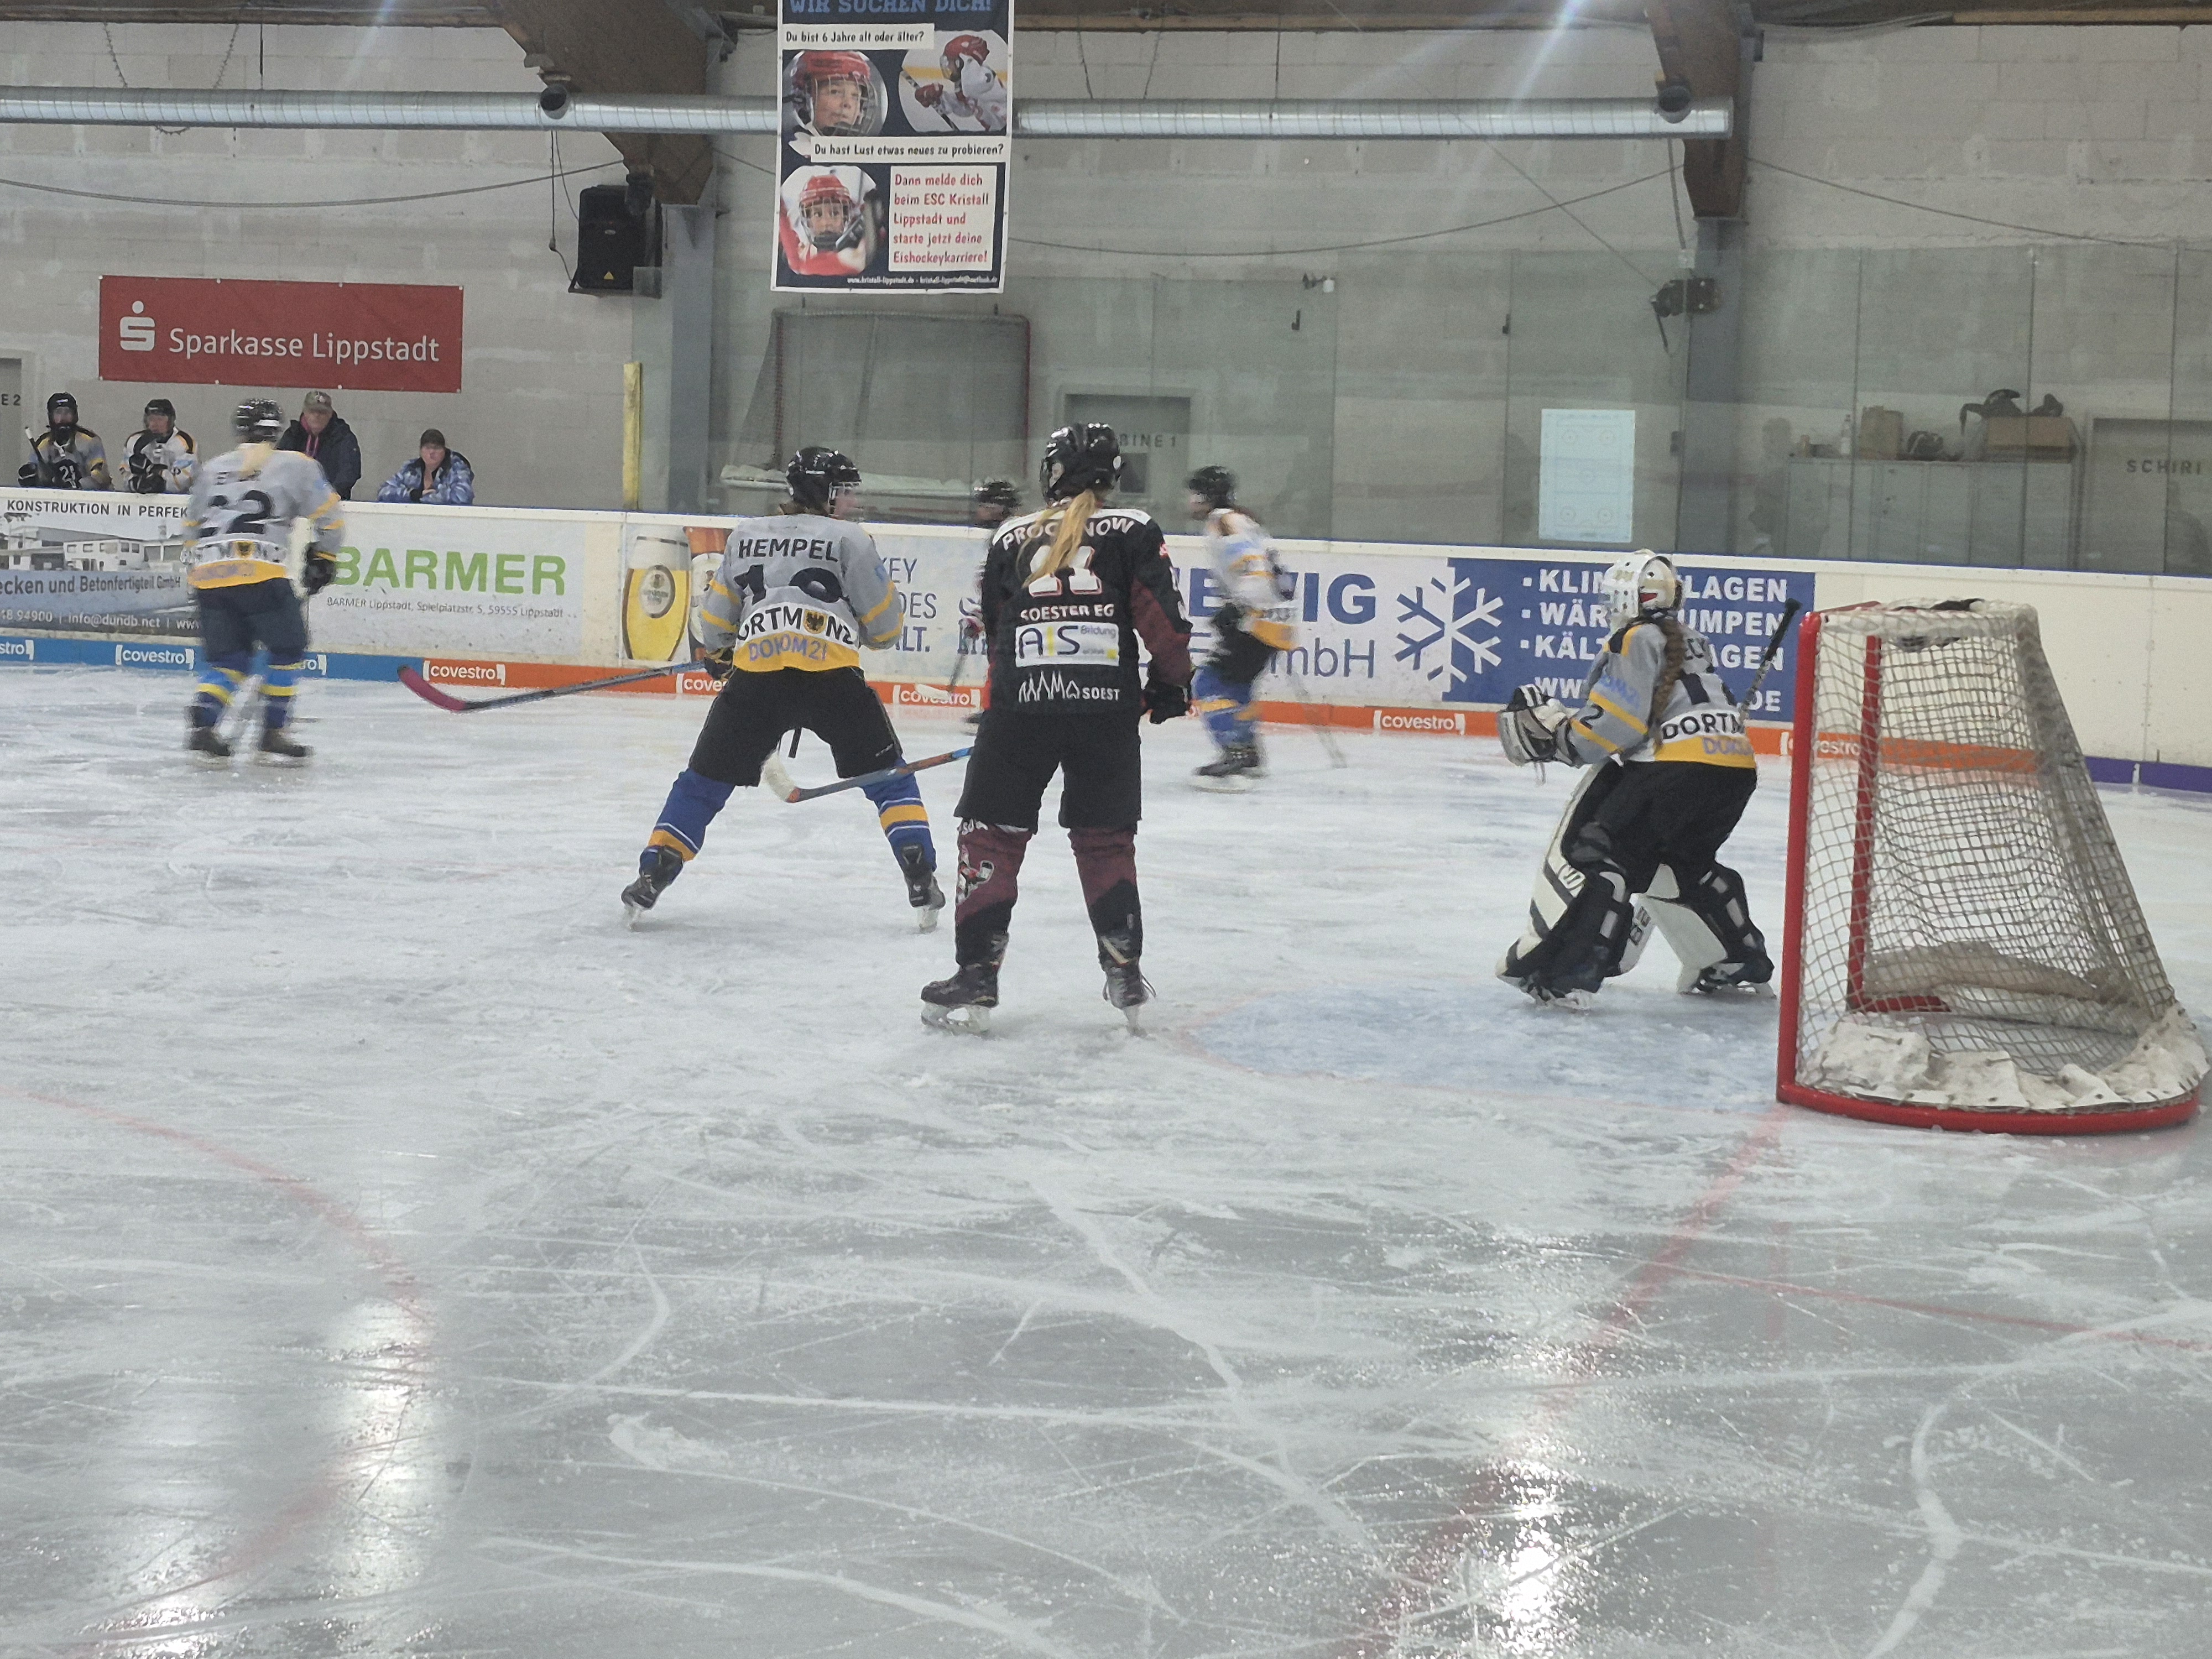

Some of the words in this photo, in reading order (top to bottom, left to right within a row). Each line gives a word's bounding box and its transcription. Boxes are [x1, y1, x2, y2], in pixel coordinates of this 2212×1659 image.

[786, 31, 797, 42] Du
[801, 31, 818, 42] bist
[822, 32, 828, 42] 6
[831, 31, 856, 43] Jahre
[859, 31, 872, 42] alt
[874, 31, 893, 42] oder
[897, 30, 925, 42] älter?
[815, 144, 826, 155] Du
[830, 144, 850, 155] hast
[854, 144, 874, 155] Lust
[877, 144, 904, 155] etwas
[907, 145, 935, 155] neues
[937, 146, 948, 155] zu
[951, 143, 1004, 158] probieren?
[895, 174, 921, 186] Dann
[925, 173, 956, 186] melde
[960, 173, 983, 186] dich
[894, 193, 919, 205] beim
[924, 193, 945, 205] ESC
[950, 193, 989, 205] Kristall
[894, 212, 942, 228] Lippstadt
[947, 212, 966, 225] und
[893, 233, 924, 244] starte
[927, 232, 951, 248] jetzt
[955, 232, 982, 244] deine
[893, 250, 987, 266] Eishockeykarriere!
[169, 328, 303, 359] Sparkasse
[313, 332, 440, 365] Lippstadt
[2127, 460, 2201, 474] SCHIRI
[7, 499, 109, 515] KONSTRUKTION
[117, 504, 131, 516] IN
[738, 539, 838, 562] HEMPEL
[331, 546, 565, 596] BARMER
[883, 557, 917, 584] EY
[49, 576, 75, 593] und
[80, 576, 155, 594] Betonfertigteil
[327, 597, 366, 608] BARMER
[488, 606, 518, 616] 59555
[1021, 605, 1089, 621] SOESTER
[1094, 604, 1114, 617] EG
[16, 610, 53, 622] 94900
[895, 626, 930, 653] LT.
[1081, 625, 1116, 639] Bildung
[123, 649, 185, 664] covestro
[1270, 638, 1375, 679] mbH
[430, 665, 497, 680] covestro
[1082, 687, 1120, 701] SOEST
[1383, 714, 1453, 731] covestro
